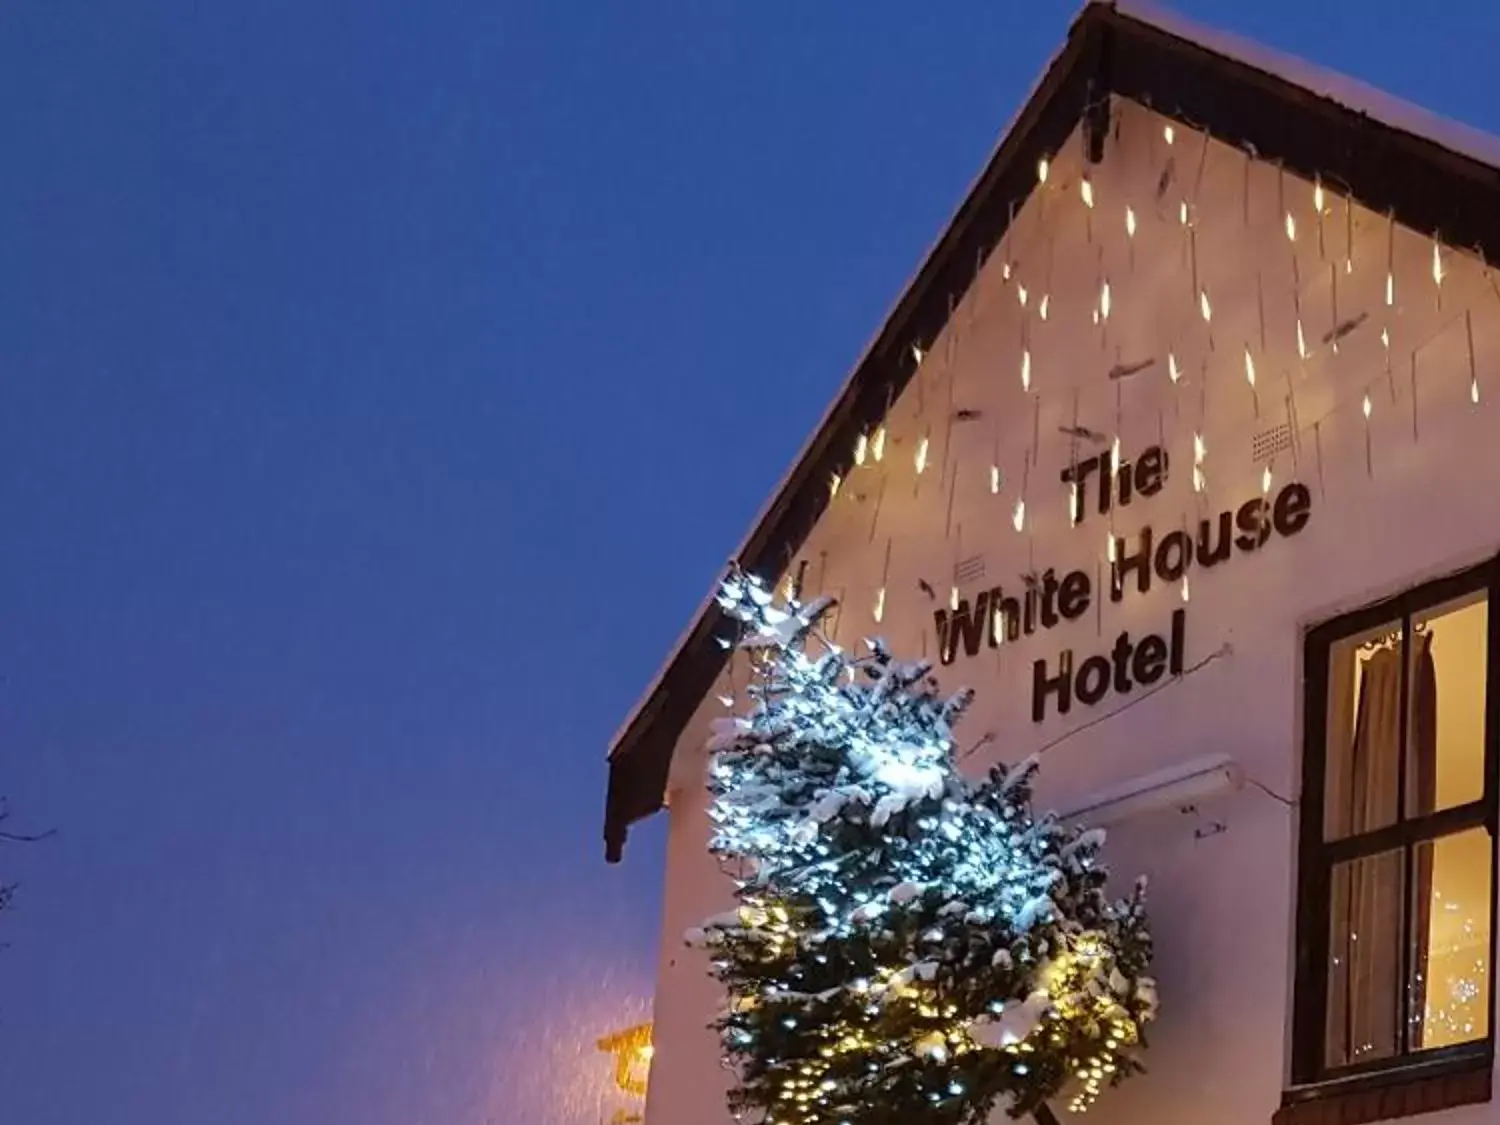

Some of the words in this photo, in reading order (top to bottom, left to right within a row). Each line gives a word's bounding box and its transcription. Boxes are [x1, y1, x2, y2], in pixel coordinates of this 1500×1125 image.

[1060, 445, 1170, 523] The
[934, 567, 1091, 665] White
[1111, 481, 1312, 602] House
[1031, 609, 1186, 723] Hotel
